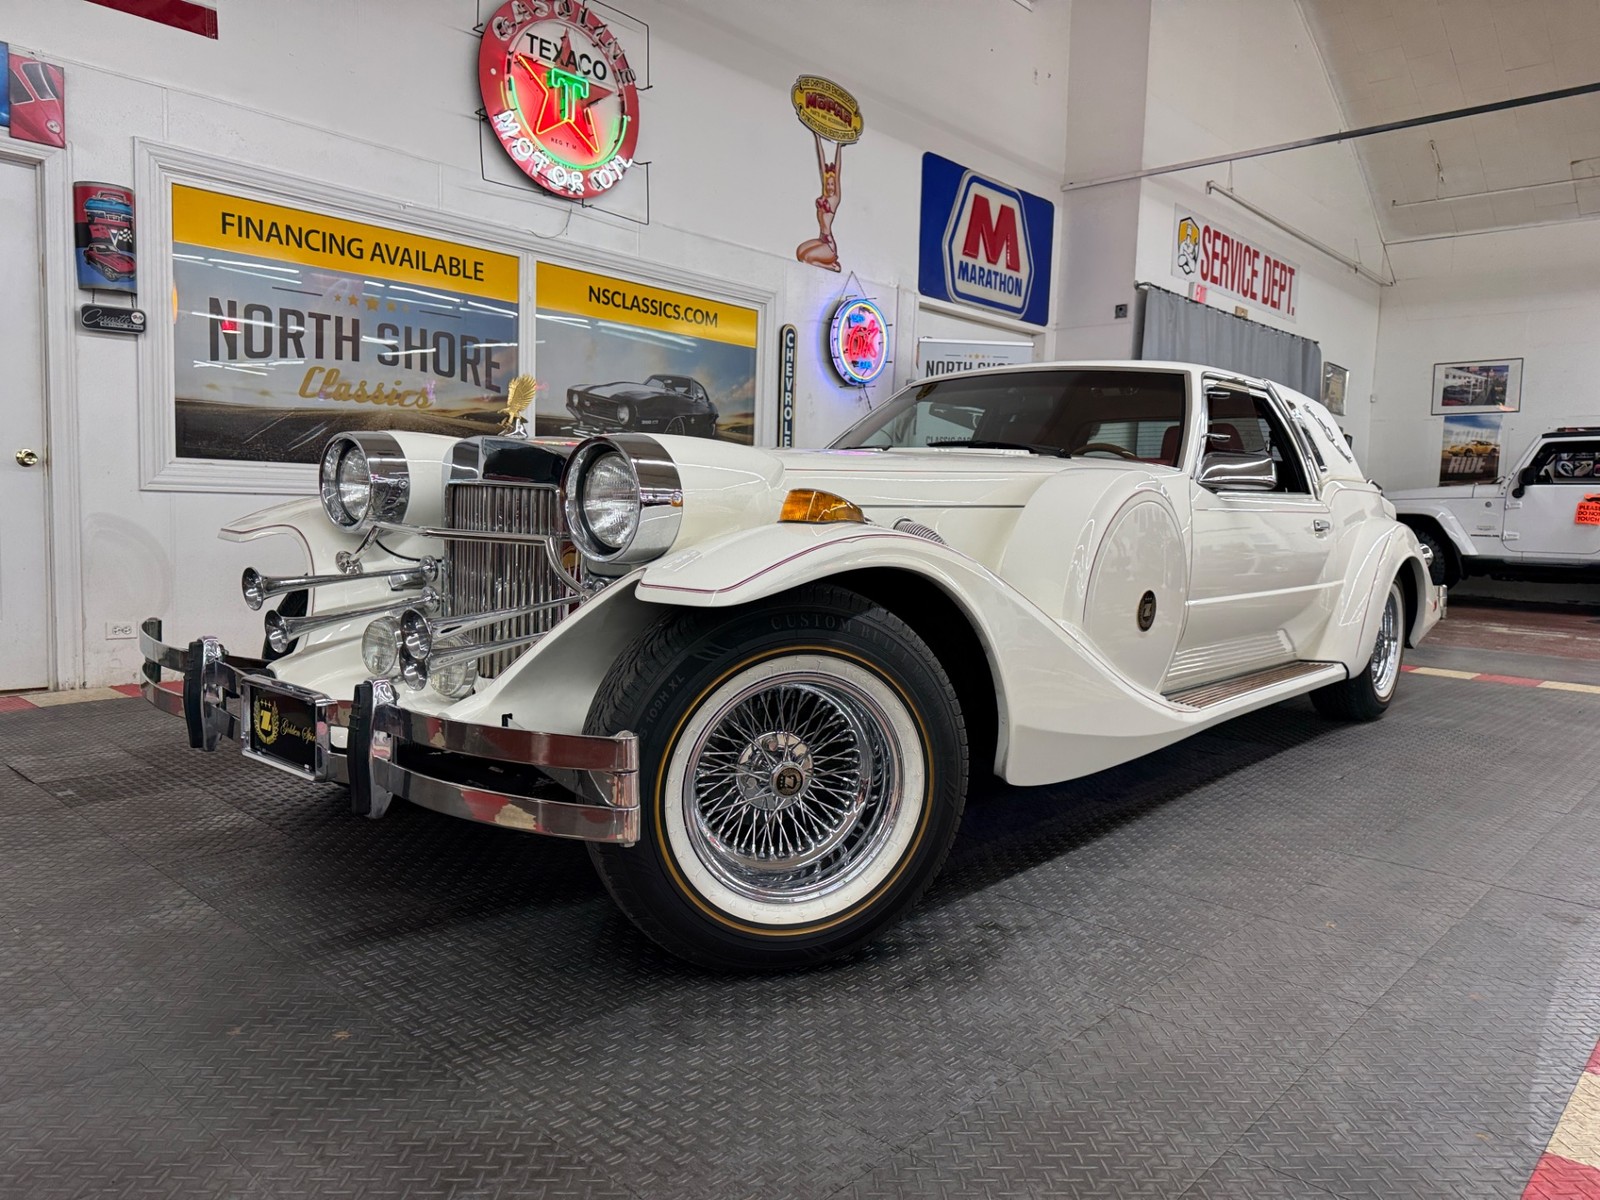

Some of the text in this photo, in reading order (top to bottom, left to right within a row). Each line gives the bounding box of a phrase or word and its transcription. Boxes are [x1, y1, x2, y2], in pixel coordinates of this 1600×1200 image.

[526, 33, 607, 81] TEXACO
[493, 109, 585, 195] MOTOR
[220, 211, 485, 282] FINANCING AVAILABLE
[1200, 224, 1296, 316] SERVICE DEPT.
[957, 260, 1023, 298] MARATHON
[588, 285, 719, 329] NSCLASSICS.COM
[208, 296, 502, 394] NORTH SHORE
[298, 365, 434, 409] Classics
[783, 333, 795, 448] CHEVROLE
[1447, 456, 1486, 473] RIDE
[770, 612, 852, 634] CUSTOM
[645, 674, 686, 724] 109H XL
